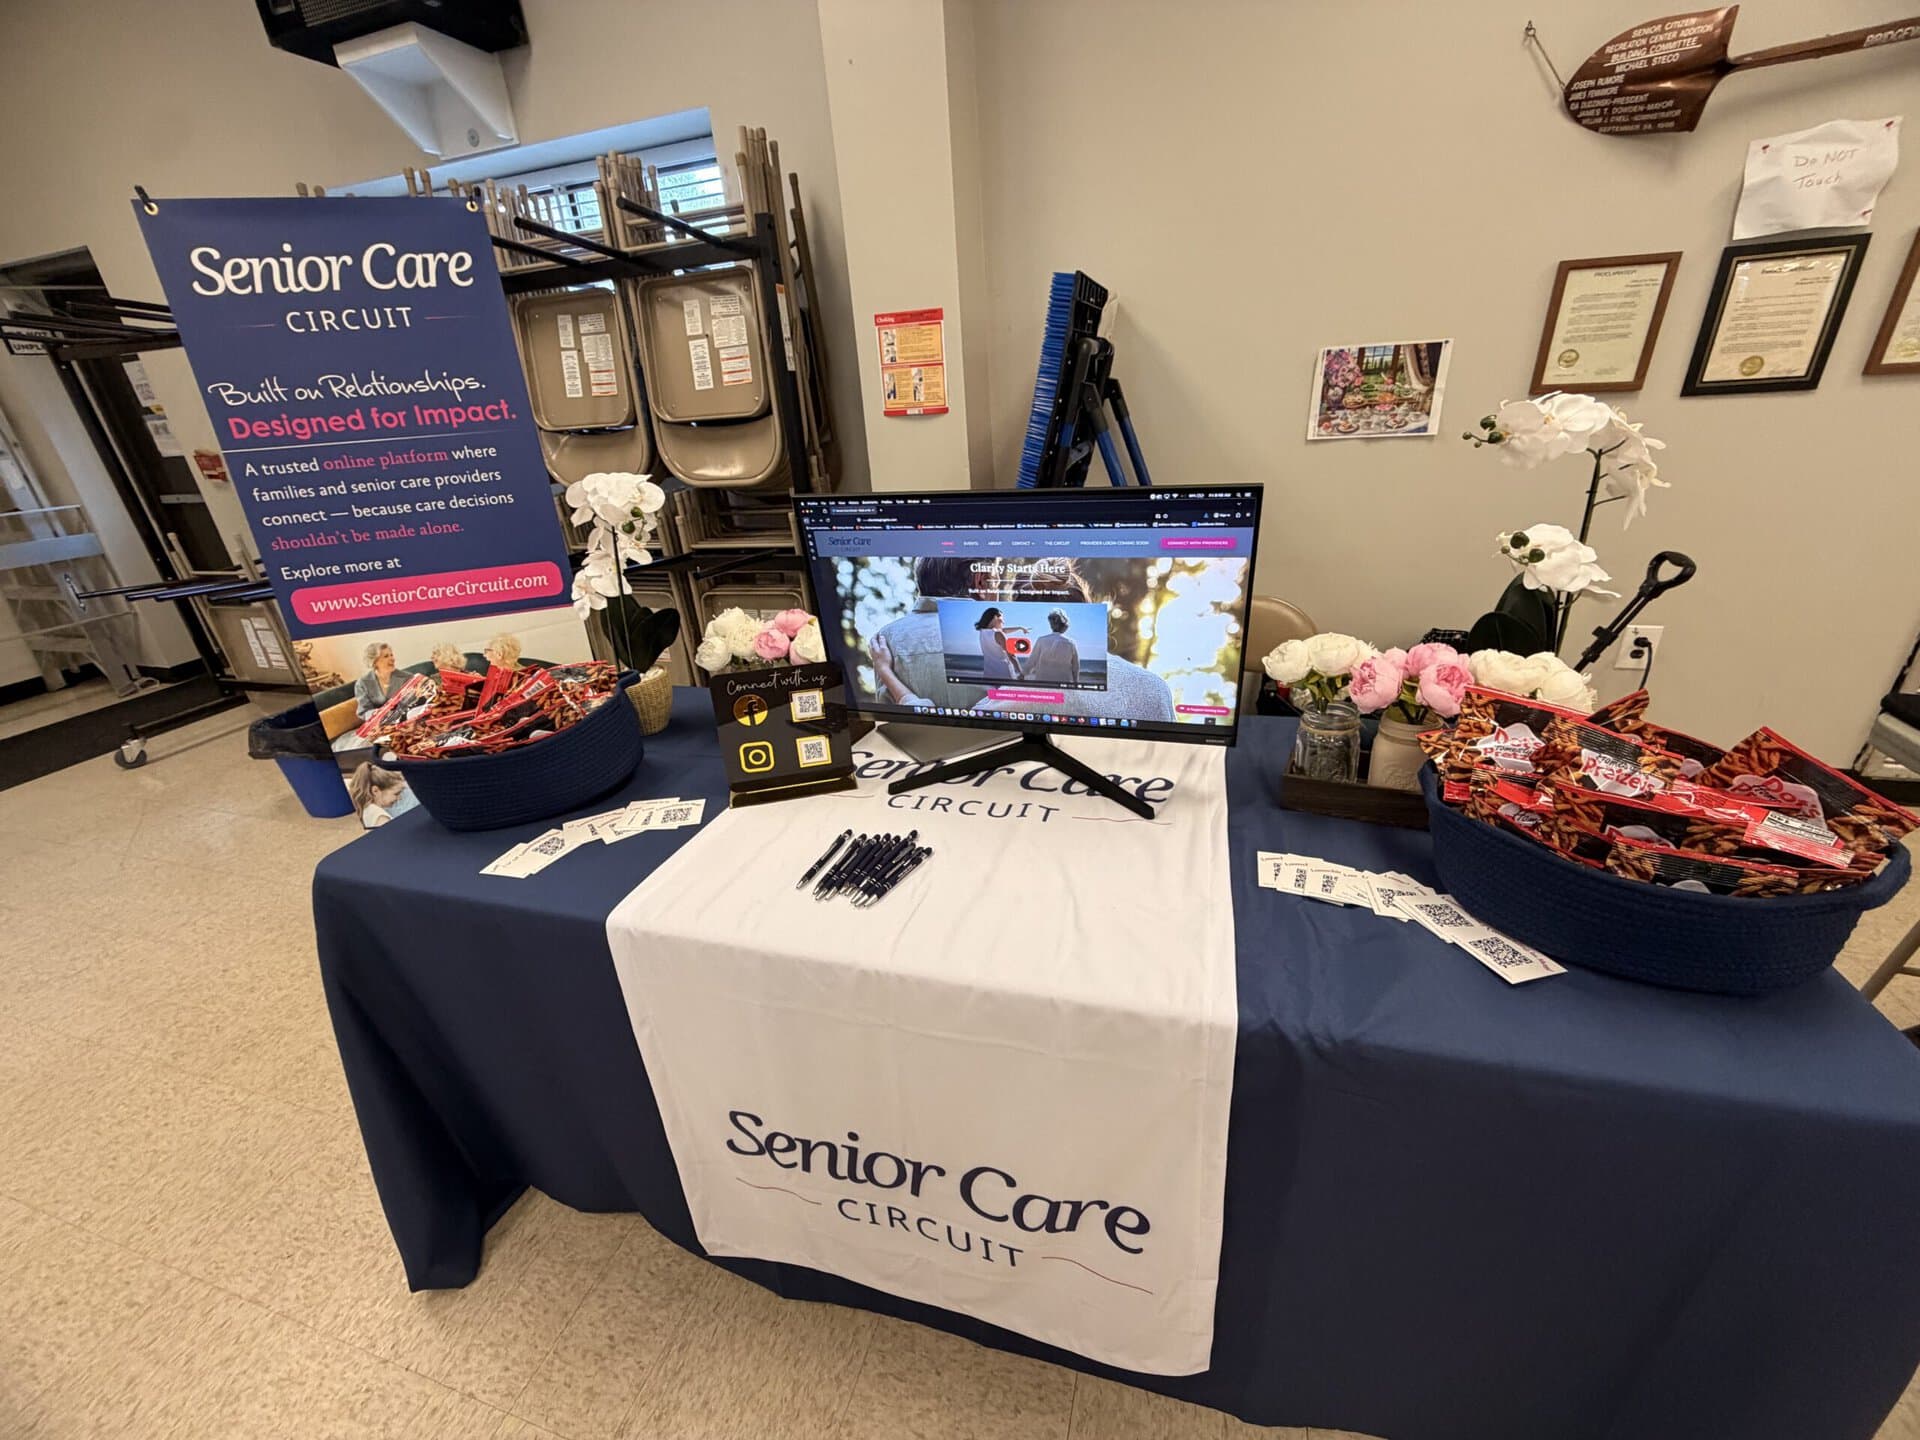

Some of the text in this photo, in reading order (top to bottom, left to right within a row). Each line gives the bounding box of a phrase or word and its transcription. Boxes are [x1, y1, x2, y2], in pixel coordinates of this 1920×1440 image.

[1632, 18, 1697, 38] SENIOR CITIZEN
[1649, 31, 1678, 44] CENTER
[1611, 36, 1699, 63] BUILDING COMMITTEE
[1794, 149, 1862, 168] Do NOT
[1792, 171, 1842, 189] Touch
[190, 242, 474, 296] Senior Care
[285, 307, 412, 333] CIRCUIT
[207, 370, 487, 406] Built on Relationships.
[228, 399, 518, 440] Designed for Impact.
[245, 445, 497, 477] A trusted online platform where
[252, 469, 502, 502] families and senior care providers
[262, 510, 328, 527] connect
[351, 504, 412, 518] because
[415, 499, 446, 512] care
[449, 493, 515, 509] decisions
[271, 522, 465, 551] shouldn't be made alone.
[828, 536, 872, 546] Senior Care
[280, 557, 402, 583] Explore more at
[970, 562, 1066, 575] Clarity Starts Here
[311, 573, 550, 613] www.SeniorCareCircuit.com
[727, 669, 827, 695] Connect with us
[887, 794, 1060, 822] CIRCUIT
[726, 1110, 1151, 1254] Senior Care
[837, 1198, 1024, 1267] CIRCUIT
